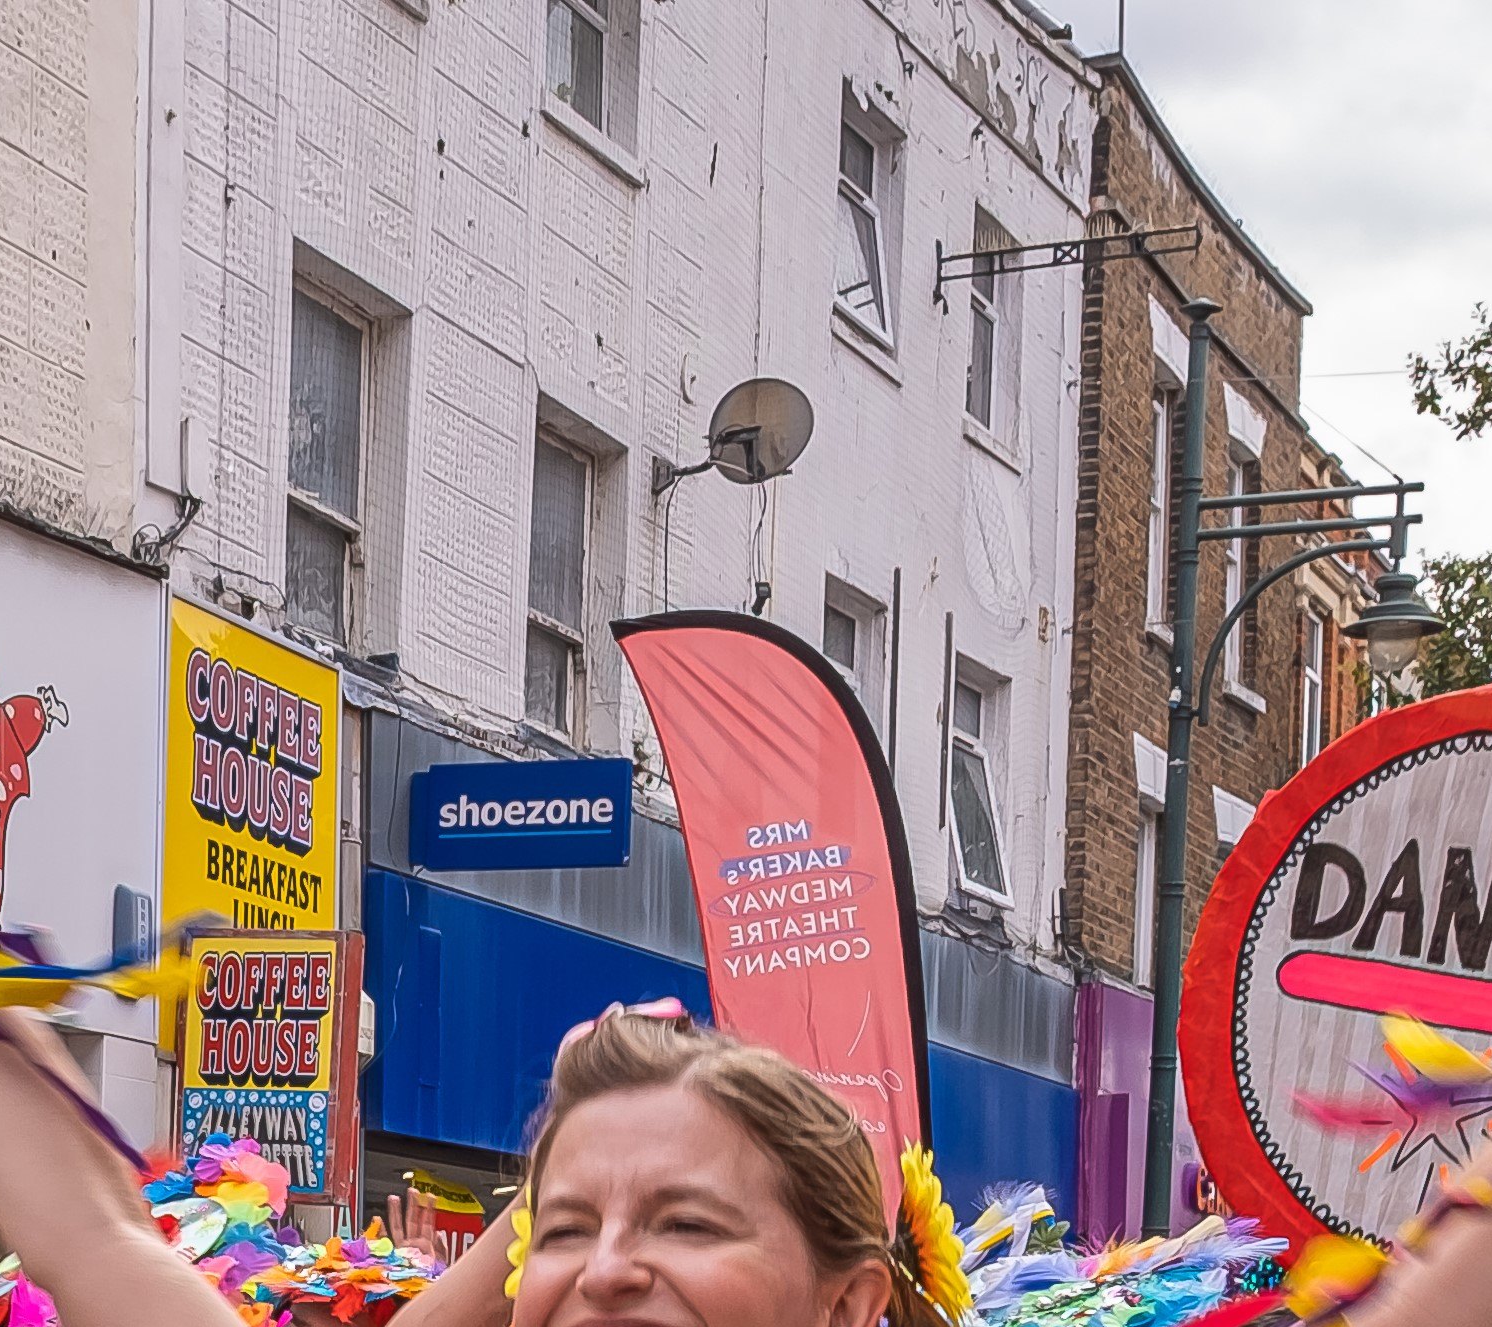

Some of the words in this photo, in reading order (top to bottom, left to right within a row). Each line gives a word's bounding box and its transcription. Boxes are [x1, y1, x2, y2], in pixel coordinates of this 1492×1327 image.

[186, 648, 322, 774] COFFEE
[192, 733, 313, 848] HOUSE
[438, 792, 613, 829] shoezone
[206, 838, 322, 914] BREAKFAST
[196, 952, 332, 1011] COFFEE
[200, 1018, 319, 1077] HOUSE
[196, 1104, 308, 1141] ALLEYWAY
